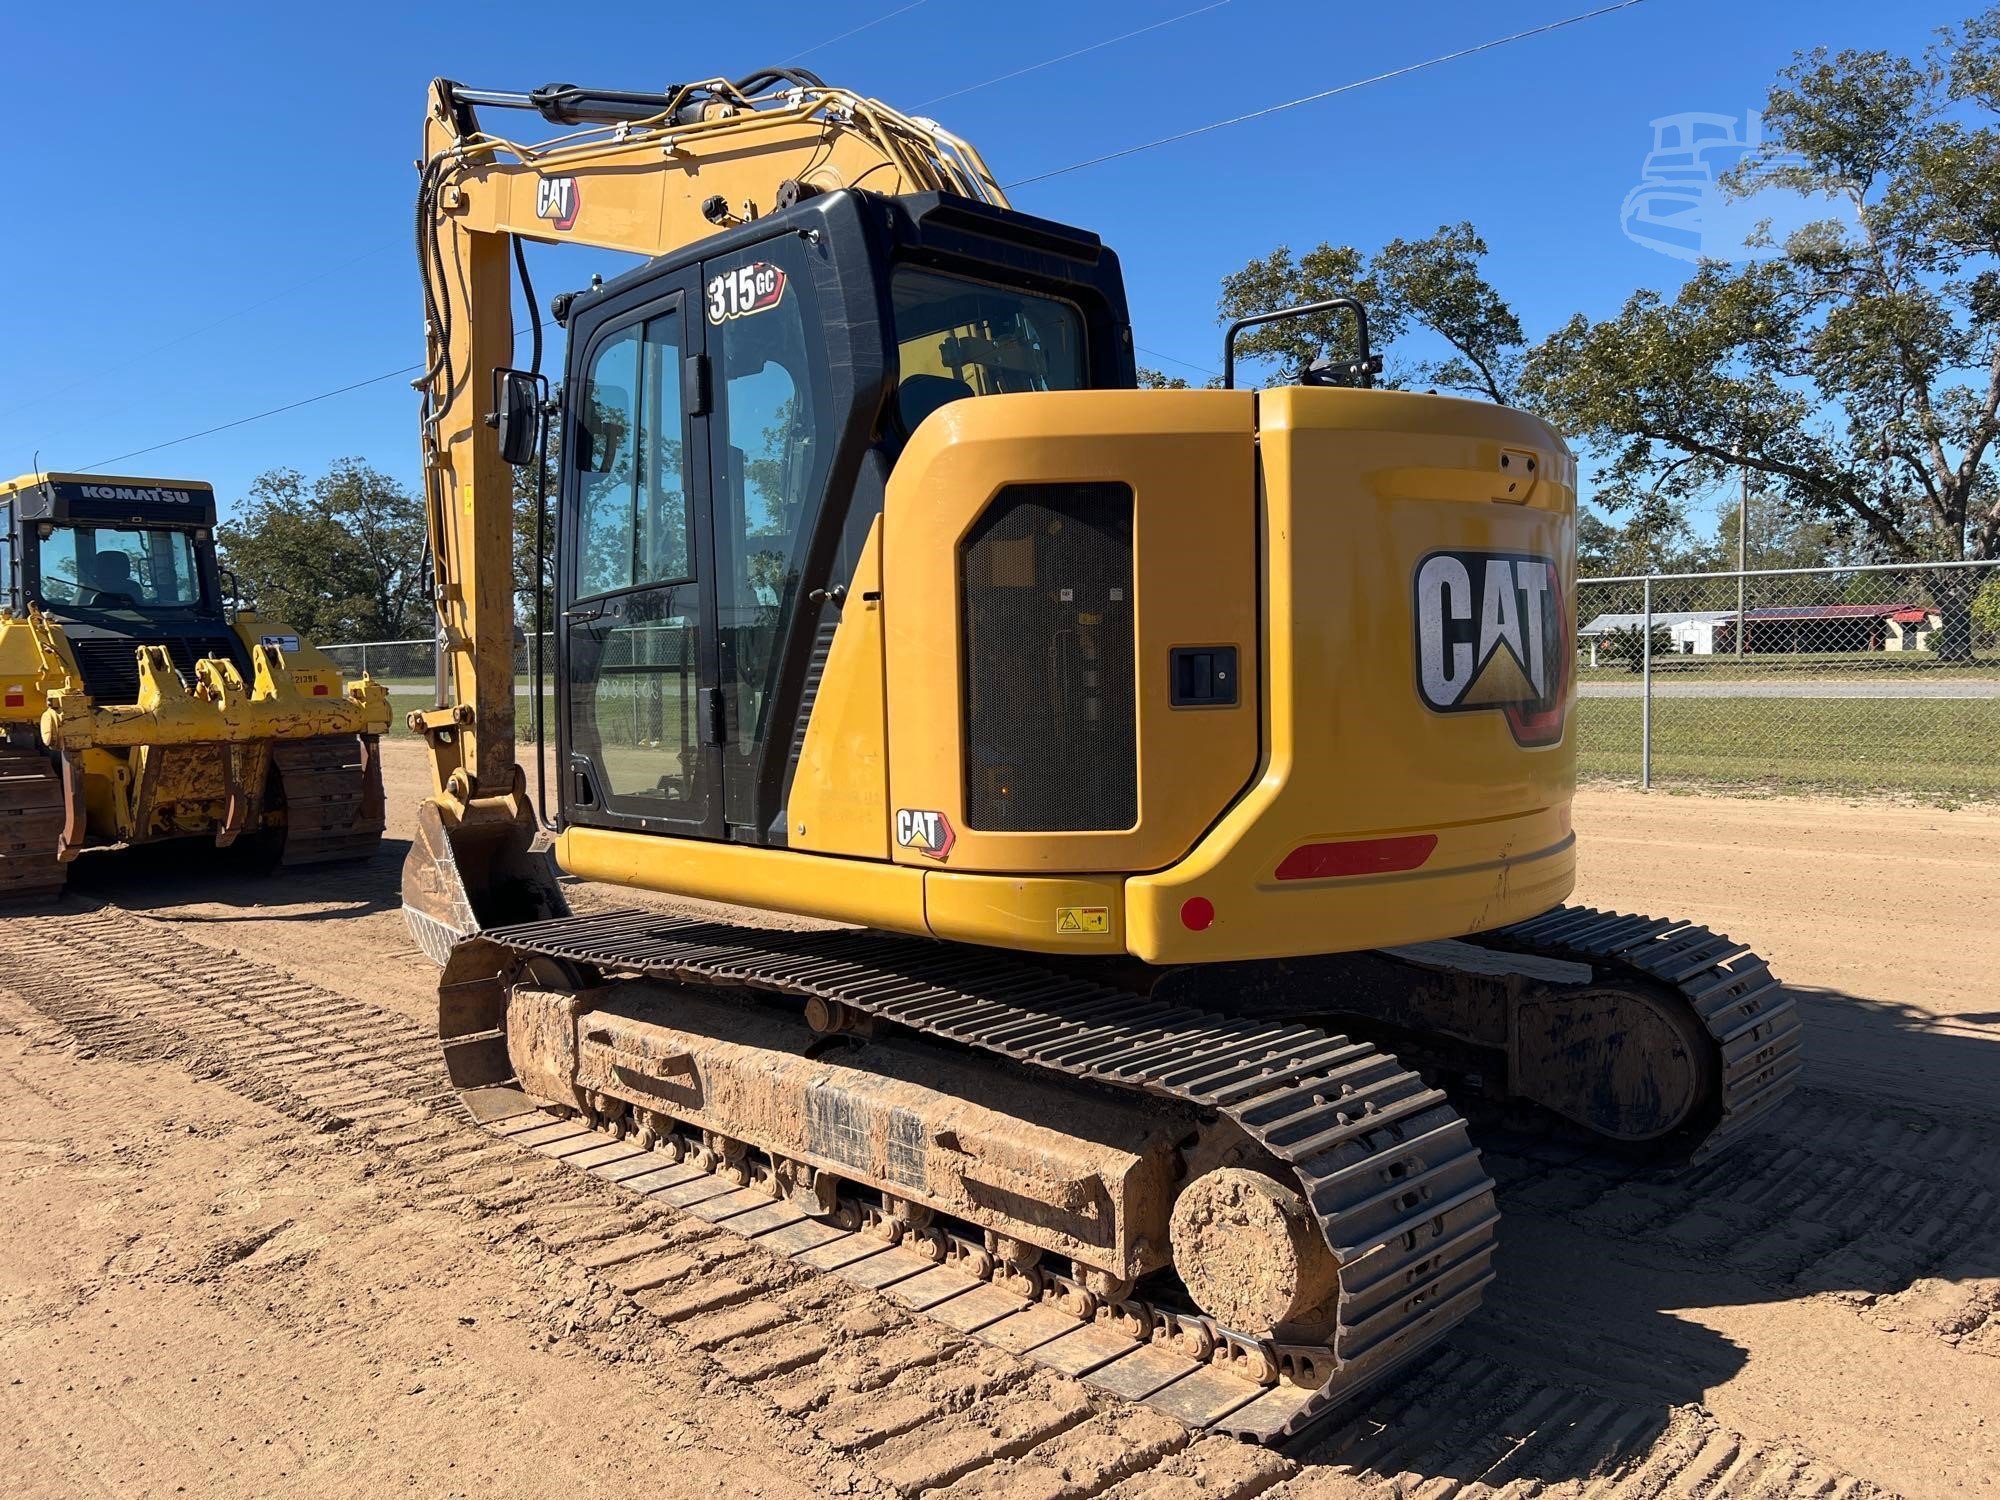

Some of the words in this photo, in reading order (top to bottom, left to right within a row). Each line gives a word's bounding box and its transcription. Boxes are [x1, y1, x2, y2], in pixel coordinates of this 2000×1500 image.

[538, 178, 571, 218] CAT
[81, 485, 190, 503] KOMATSU
[1418, 556, 1548, 706] CAT
[897, 809, 939, 848] CAT
